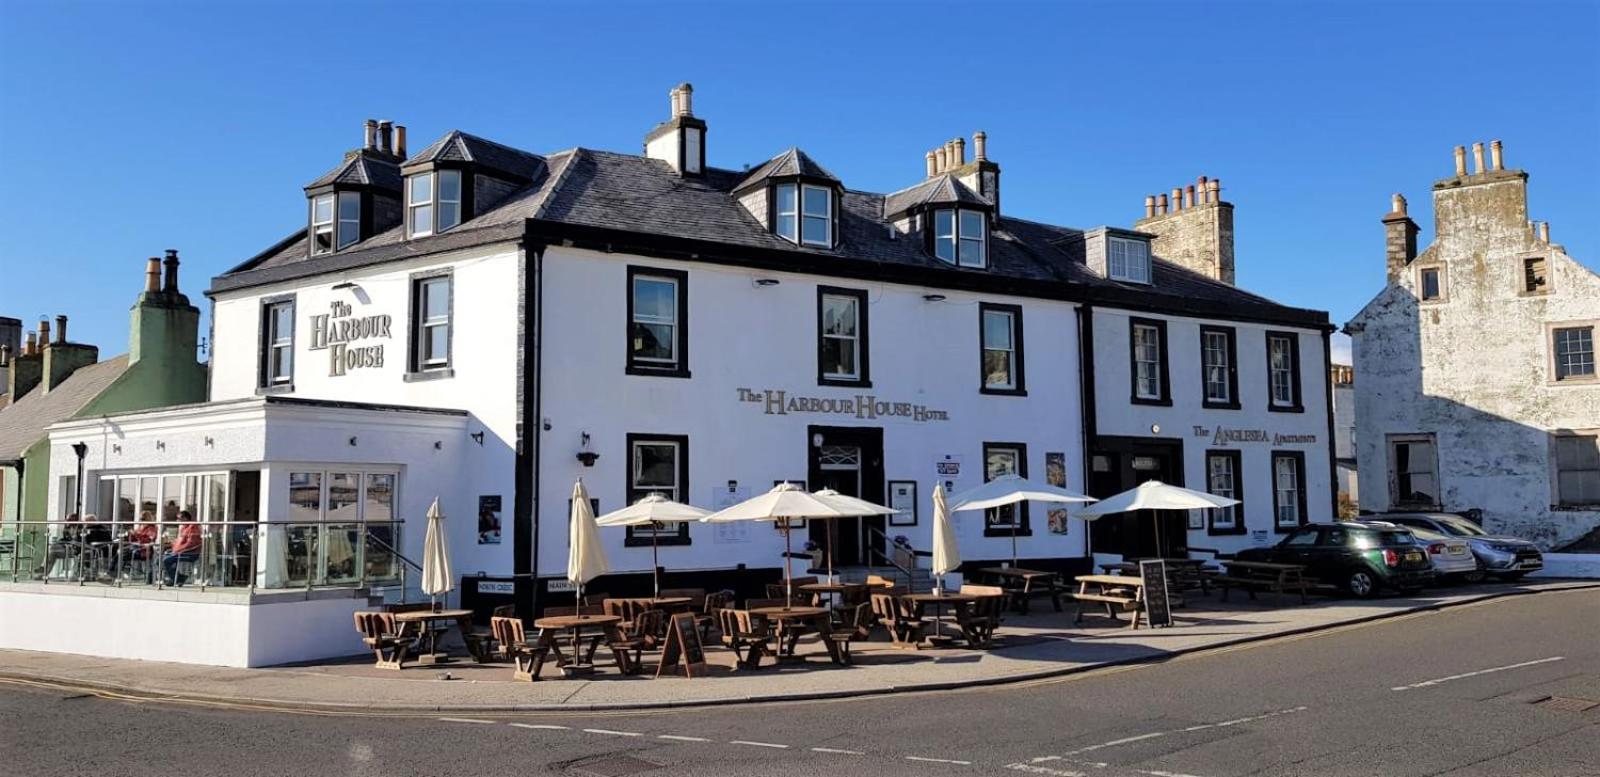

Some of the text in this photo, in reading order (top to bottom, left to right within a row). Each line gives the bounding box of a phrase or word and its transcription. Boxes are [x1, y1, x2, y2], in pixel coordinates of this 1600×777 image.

[330, 300, 352, 319] The
[309, 314, 391, 350] HARBOUR
[328, 343, 384, 377] HOUSE
[737, 387, 762, 402] The
[764, 389, 855, 415] HARBOUR
[855, 394, 911, 418] HOUSE
[1192, 425, 1210, 437] The
[1212, 425, 1269, 445] ANGLESEA
